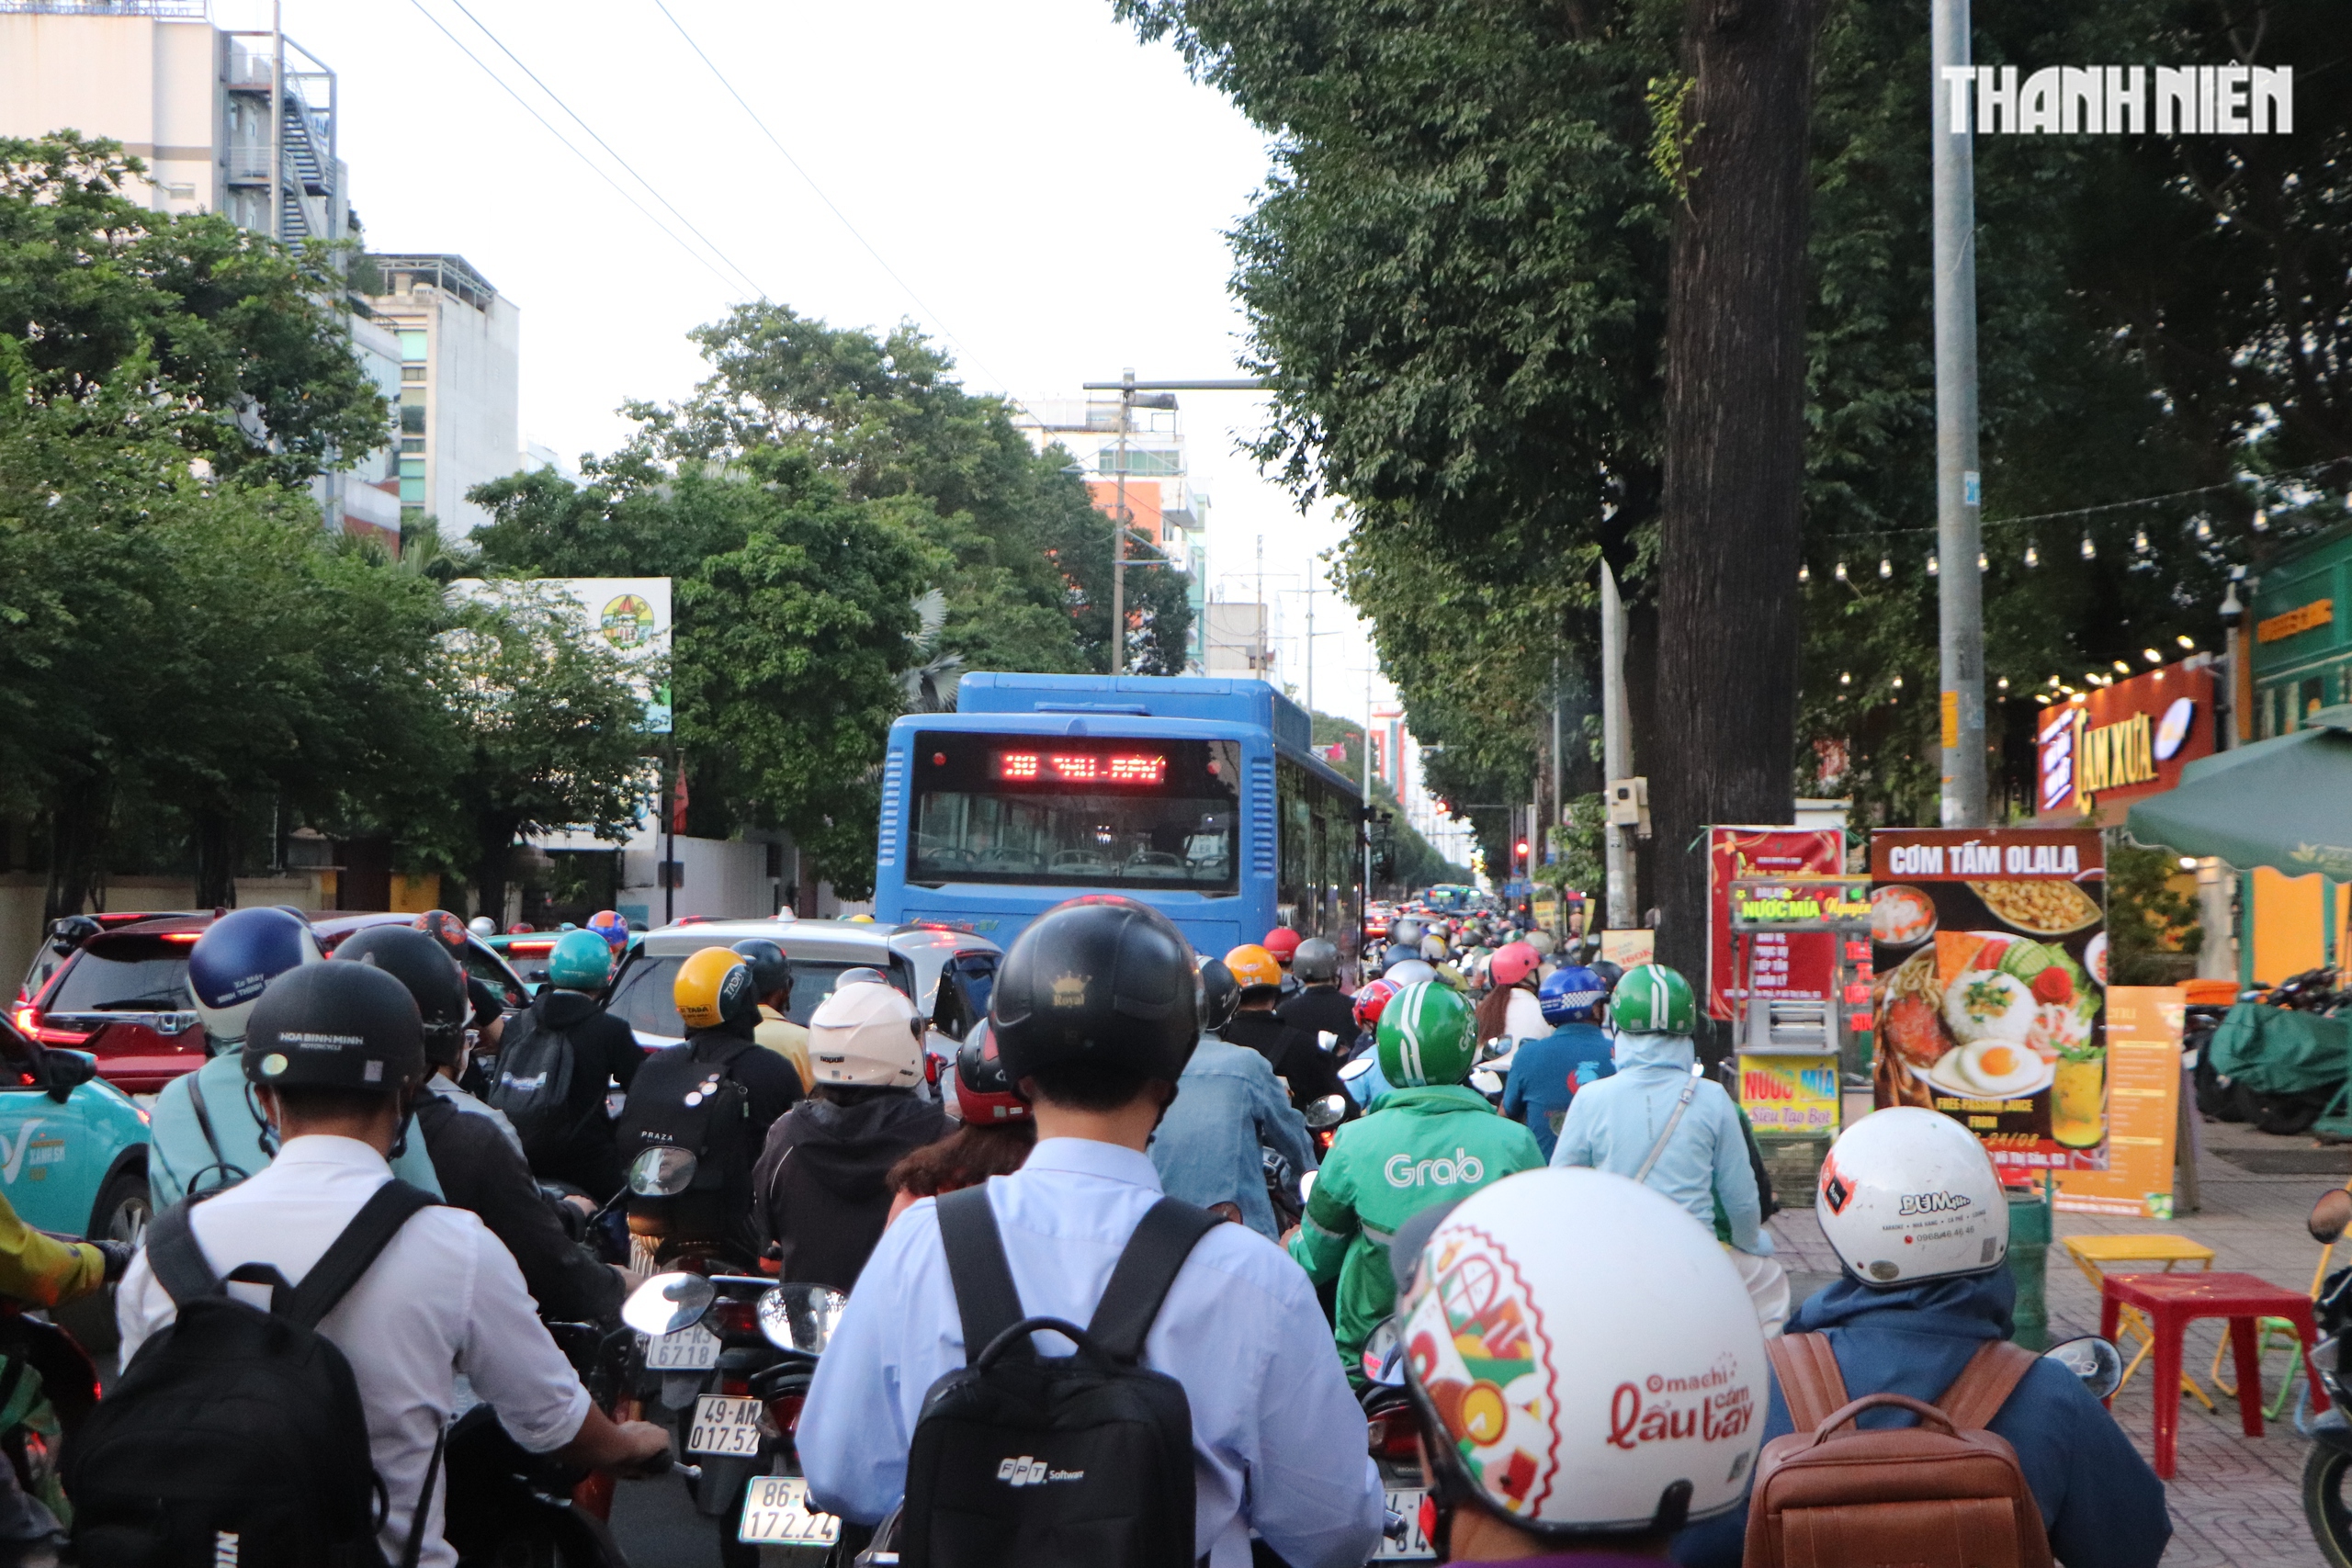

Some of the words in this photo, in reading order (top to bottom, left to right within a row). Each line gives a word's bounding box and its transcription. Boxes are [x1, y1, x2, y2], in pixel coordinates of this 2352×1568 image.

[1889, 843, 1944, 874] CƠM
[1948, 839, 2002, 874] TẤM
[2005, 844, 2079, 874] OLALA
[1742, 895, 1788, 918] NƯỚC
[1789, 896, 1821, 918] MÍA
[1053, 993, 1085, 1007] Royal
[641, 1130, 673, 1142] PRAZA
[1384, 1147, 1485, 1188] Grab
[658, 1345, 710, 1366] 6718
[704, 1399, 760, 1426] 49-AM
[997, 1456, 1048, 1486] FPT
[1048, 1469, 1085, 1481] Software
[762, 1481, 801, 1508] 86-
[750, 1510, 833, 1540] 172.24
